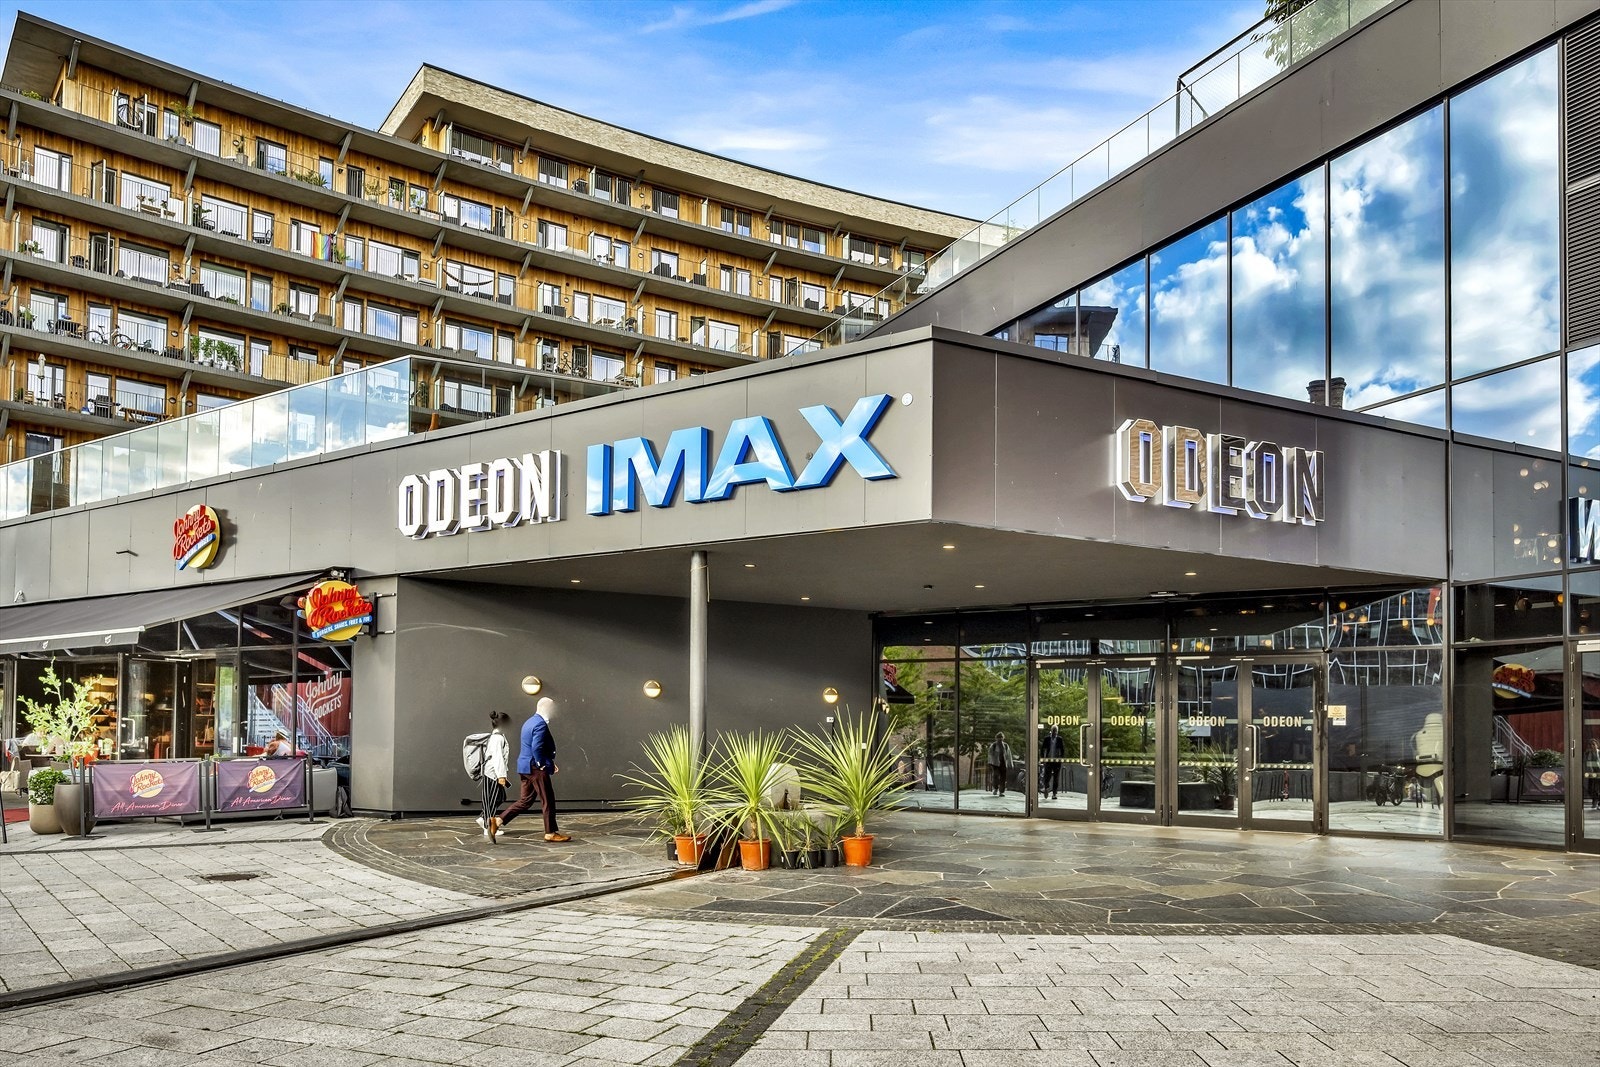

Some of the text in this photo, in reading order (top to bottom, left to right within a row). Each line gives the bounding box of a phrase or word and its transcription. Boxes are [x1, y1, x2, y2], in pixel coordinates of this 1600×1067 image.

[398, 393, 898, 540] ODEON IMAX
[1115, 418, 1325, 527] ODEON
[173, 504, 206, 541] Johnny
[309, 585, 358, 609] Johnny
[307, 600, 373, 629] Rockets
[305, 671, 342, 713] Johnny
[313, 697, 342, 720] ROCKETS
[1047, 715, 1079, 726] ODEON
[1110, 715, 1145, 726] ODEON
[1188, 716, 1225, 727] ODEON
[1263, 716, 1302, 727] ODEON
[125, 802, 160, 812] American
